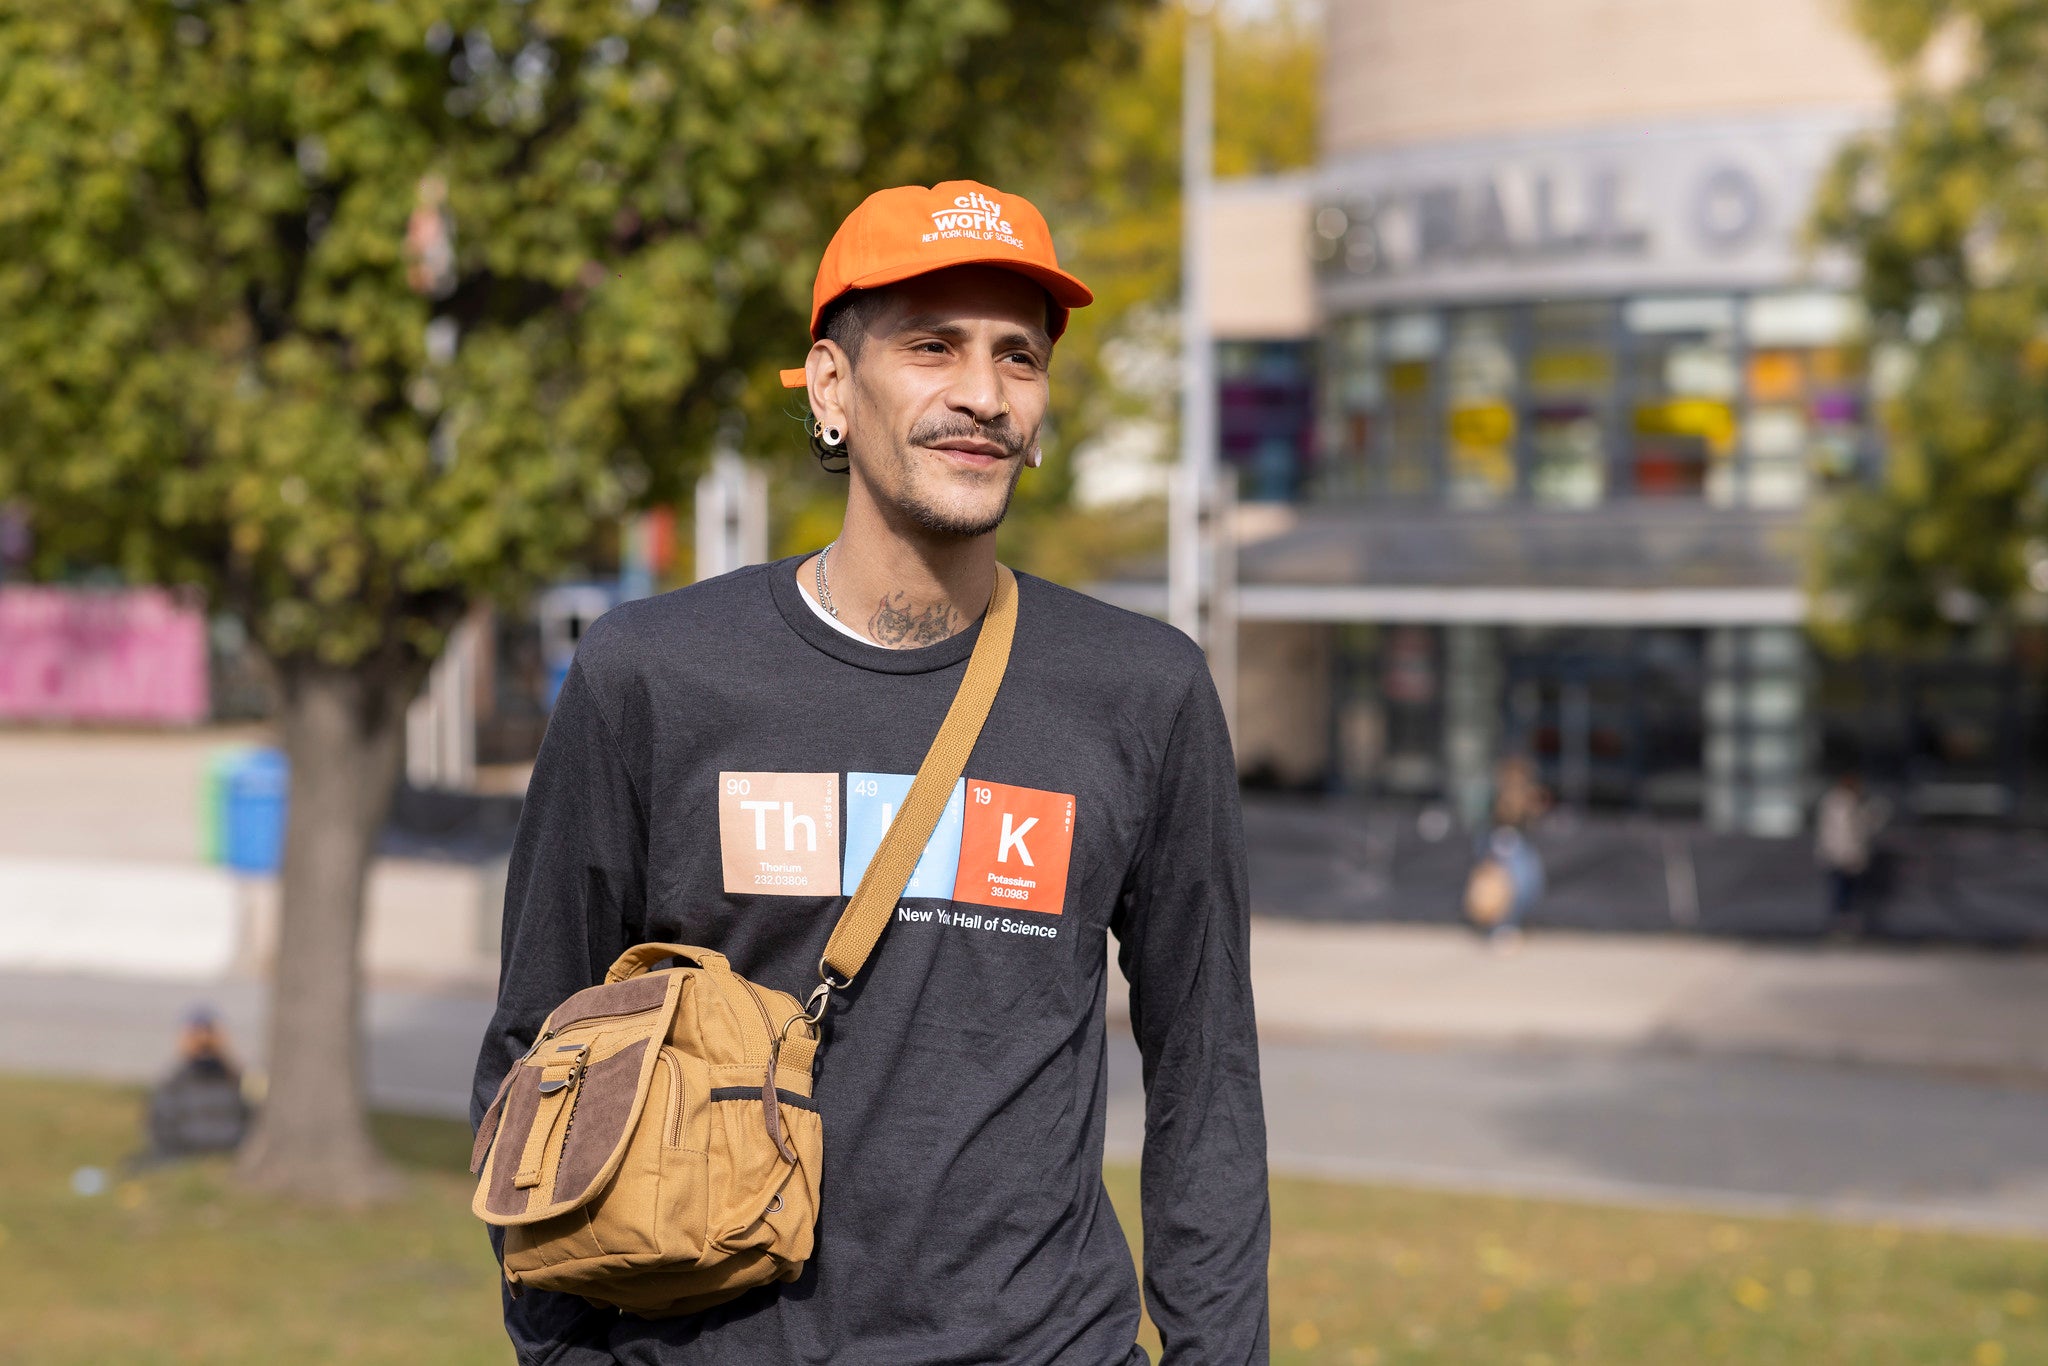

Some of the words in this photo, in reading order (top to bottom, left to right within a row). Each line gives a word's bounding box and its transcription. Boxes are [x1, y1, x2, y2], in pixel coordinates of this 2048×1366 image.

[953, 191, 1001, 218] city
[933, 211, 1014, 235] works
[922, 231, 939, 243] NEW
[941, 229, 962, 240] YORK
[963, 229, 982, 240] HALL
[983, 231, 994, 240] OF
[995, 231, 1025, 250] SCIENCE
[726, 778, 751, 795] 90
[854, 780, 878, 797] 49
[973, 786, 993, 805] 19
[740, 800, 817, 852] Th
[997, 812, 1040, 867] K
[760, 862, 802, 873] Thorium
[754, 874, 809, 886] 232.03806
[987, 872, 1037, 889] Potassium
[990, 886, 1029, 901] 39.0983
[898, 907, 933, 922] New
[952, 912, 982, 930] Hall
[984, 917, 1000, 931] of
[1000, 918, 1058, 938] Science
